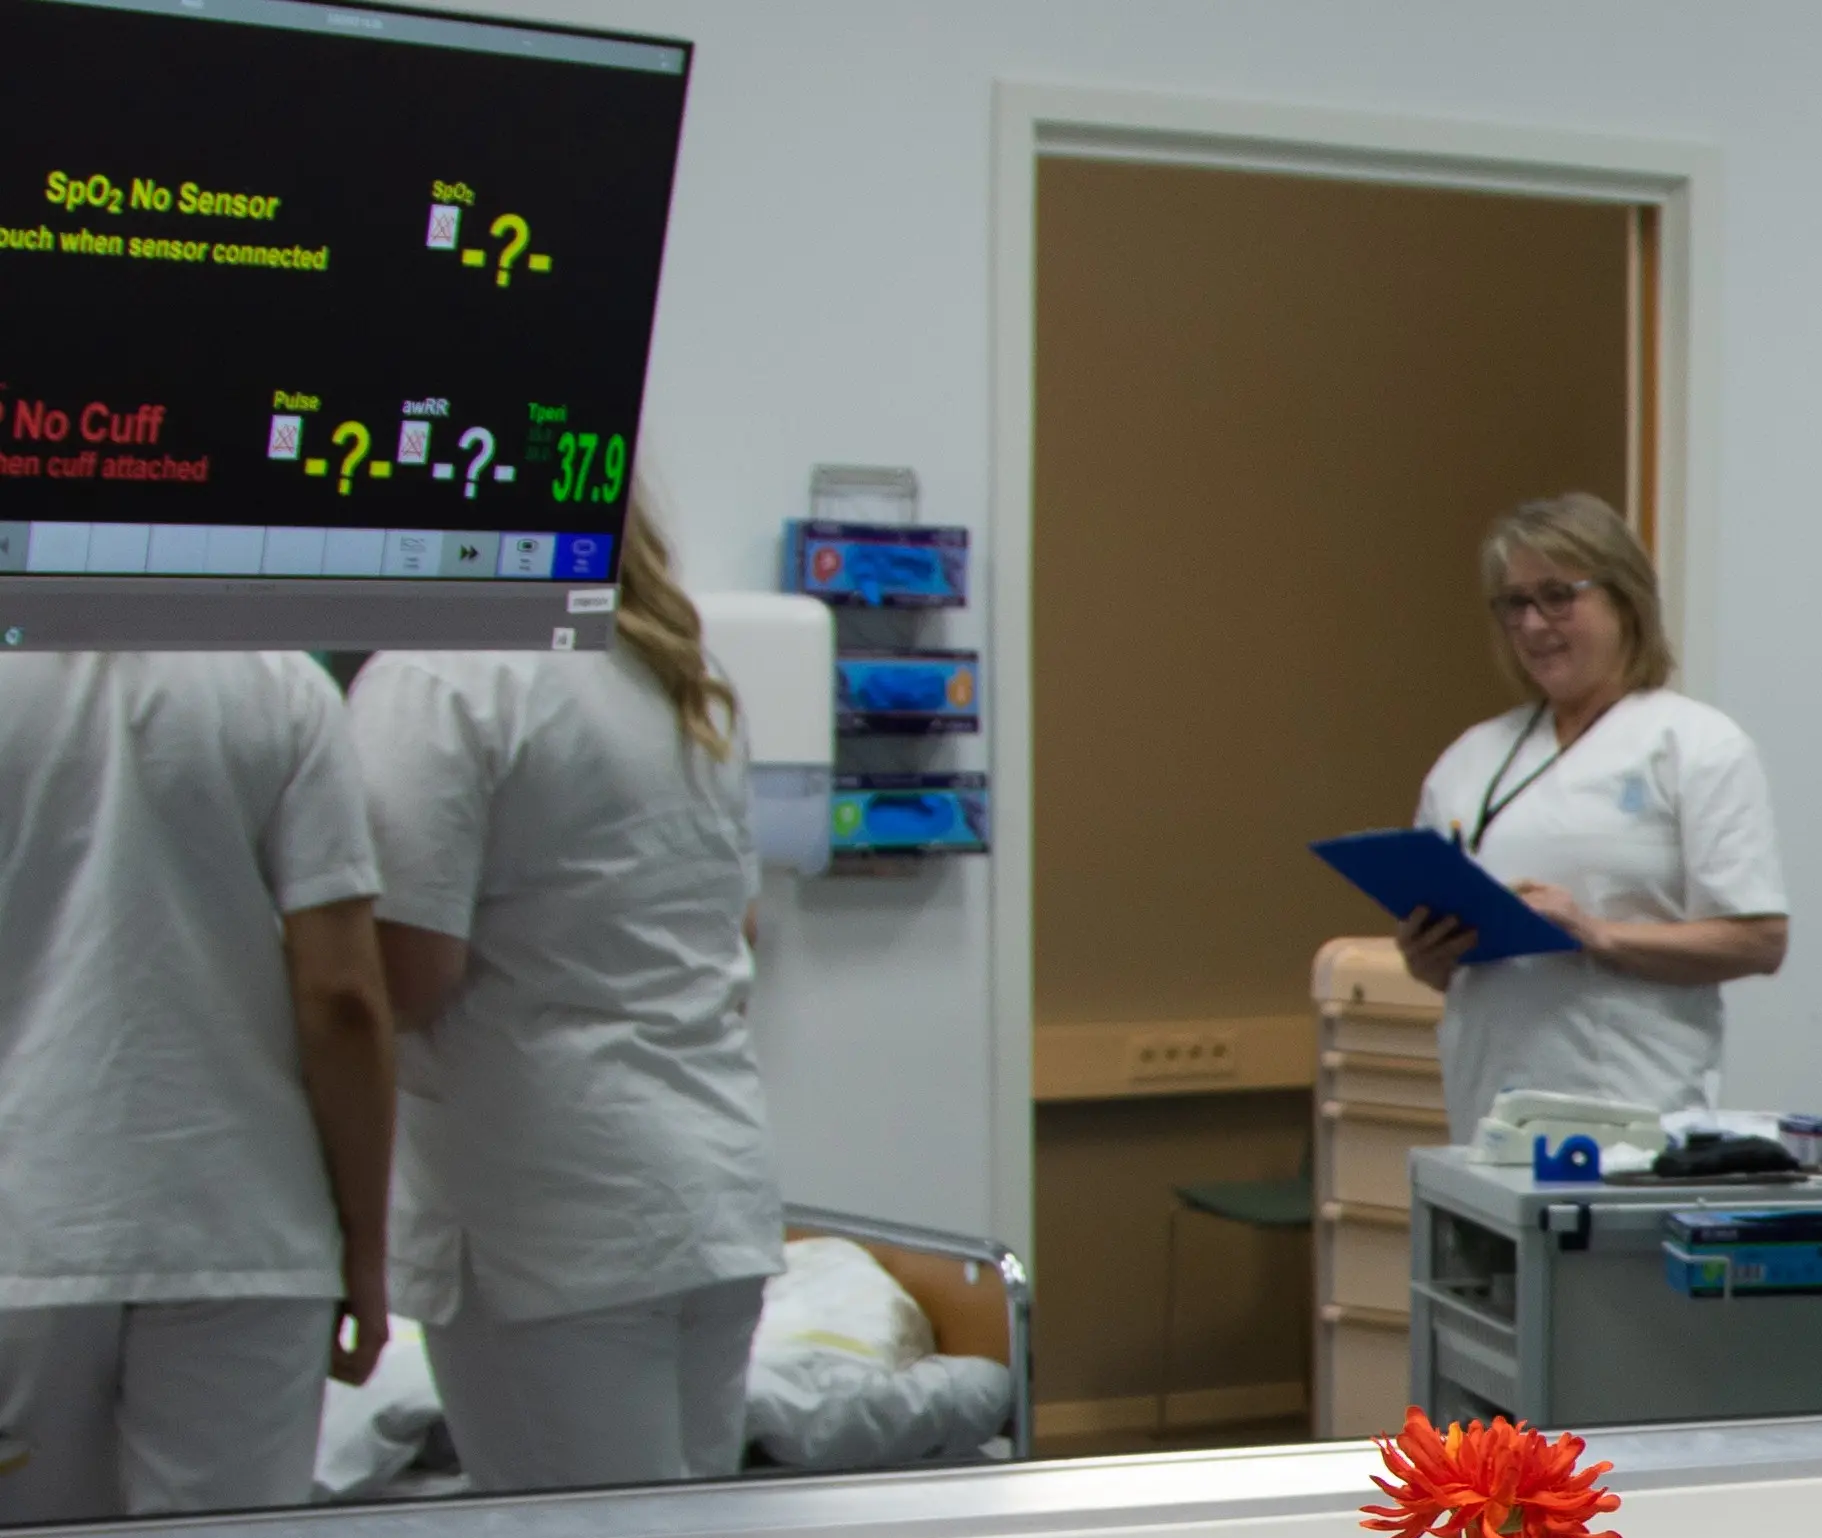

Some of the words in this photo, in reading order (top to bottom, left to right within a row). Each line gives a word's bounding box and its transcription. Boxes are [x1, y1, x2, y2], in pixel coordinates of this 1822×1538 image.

[130, 178, 172, 211] No
[178, 182, 281, 220] Sensor
[60, 228, 124, 255] when
[129, 237, 208, 261] sensor
[212, 244, 329, 271] connected
[273, 389, 321, 412] Pulse
[402, 398, 450, 417] awRR
[13, 399, 70, 442] No
[80, 401, 167, 445] Cuff
[47, 451, 98, 478] cuff
[102, 453, 209, 482] attached
[552, 432, 625, 503] 37.9
